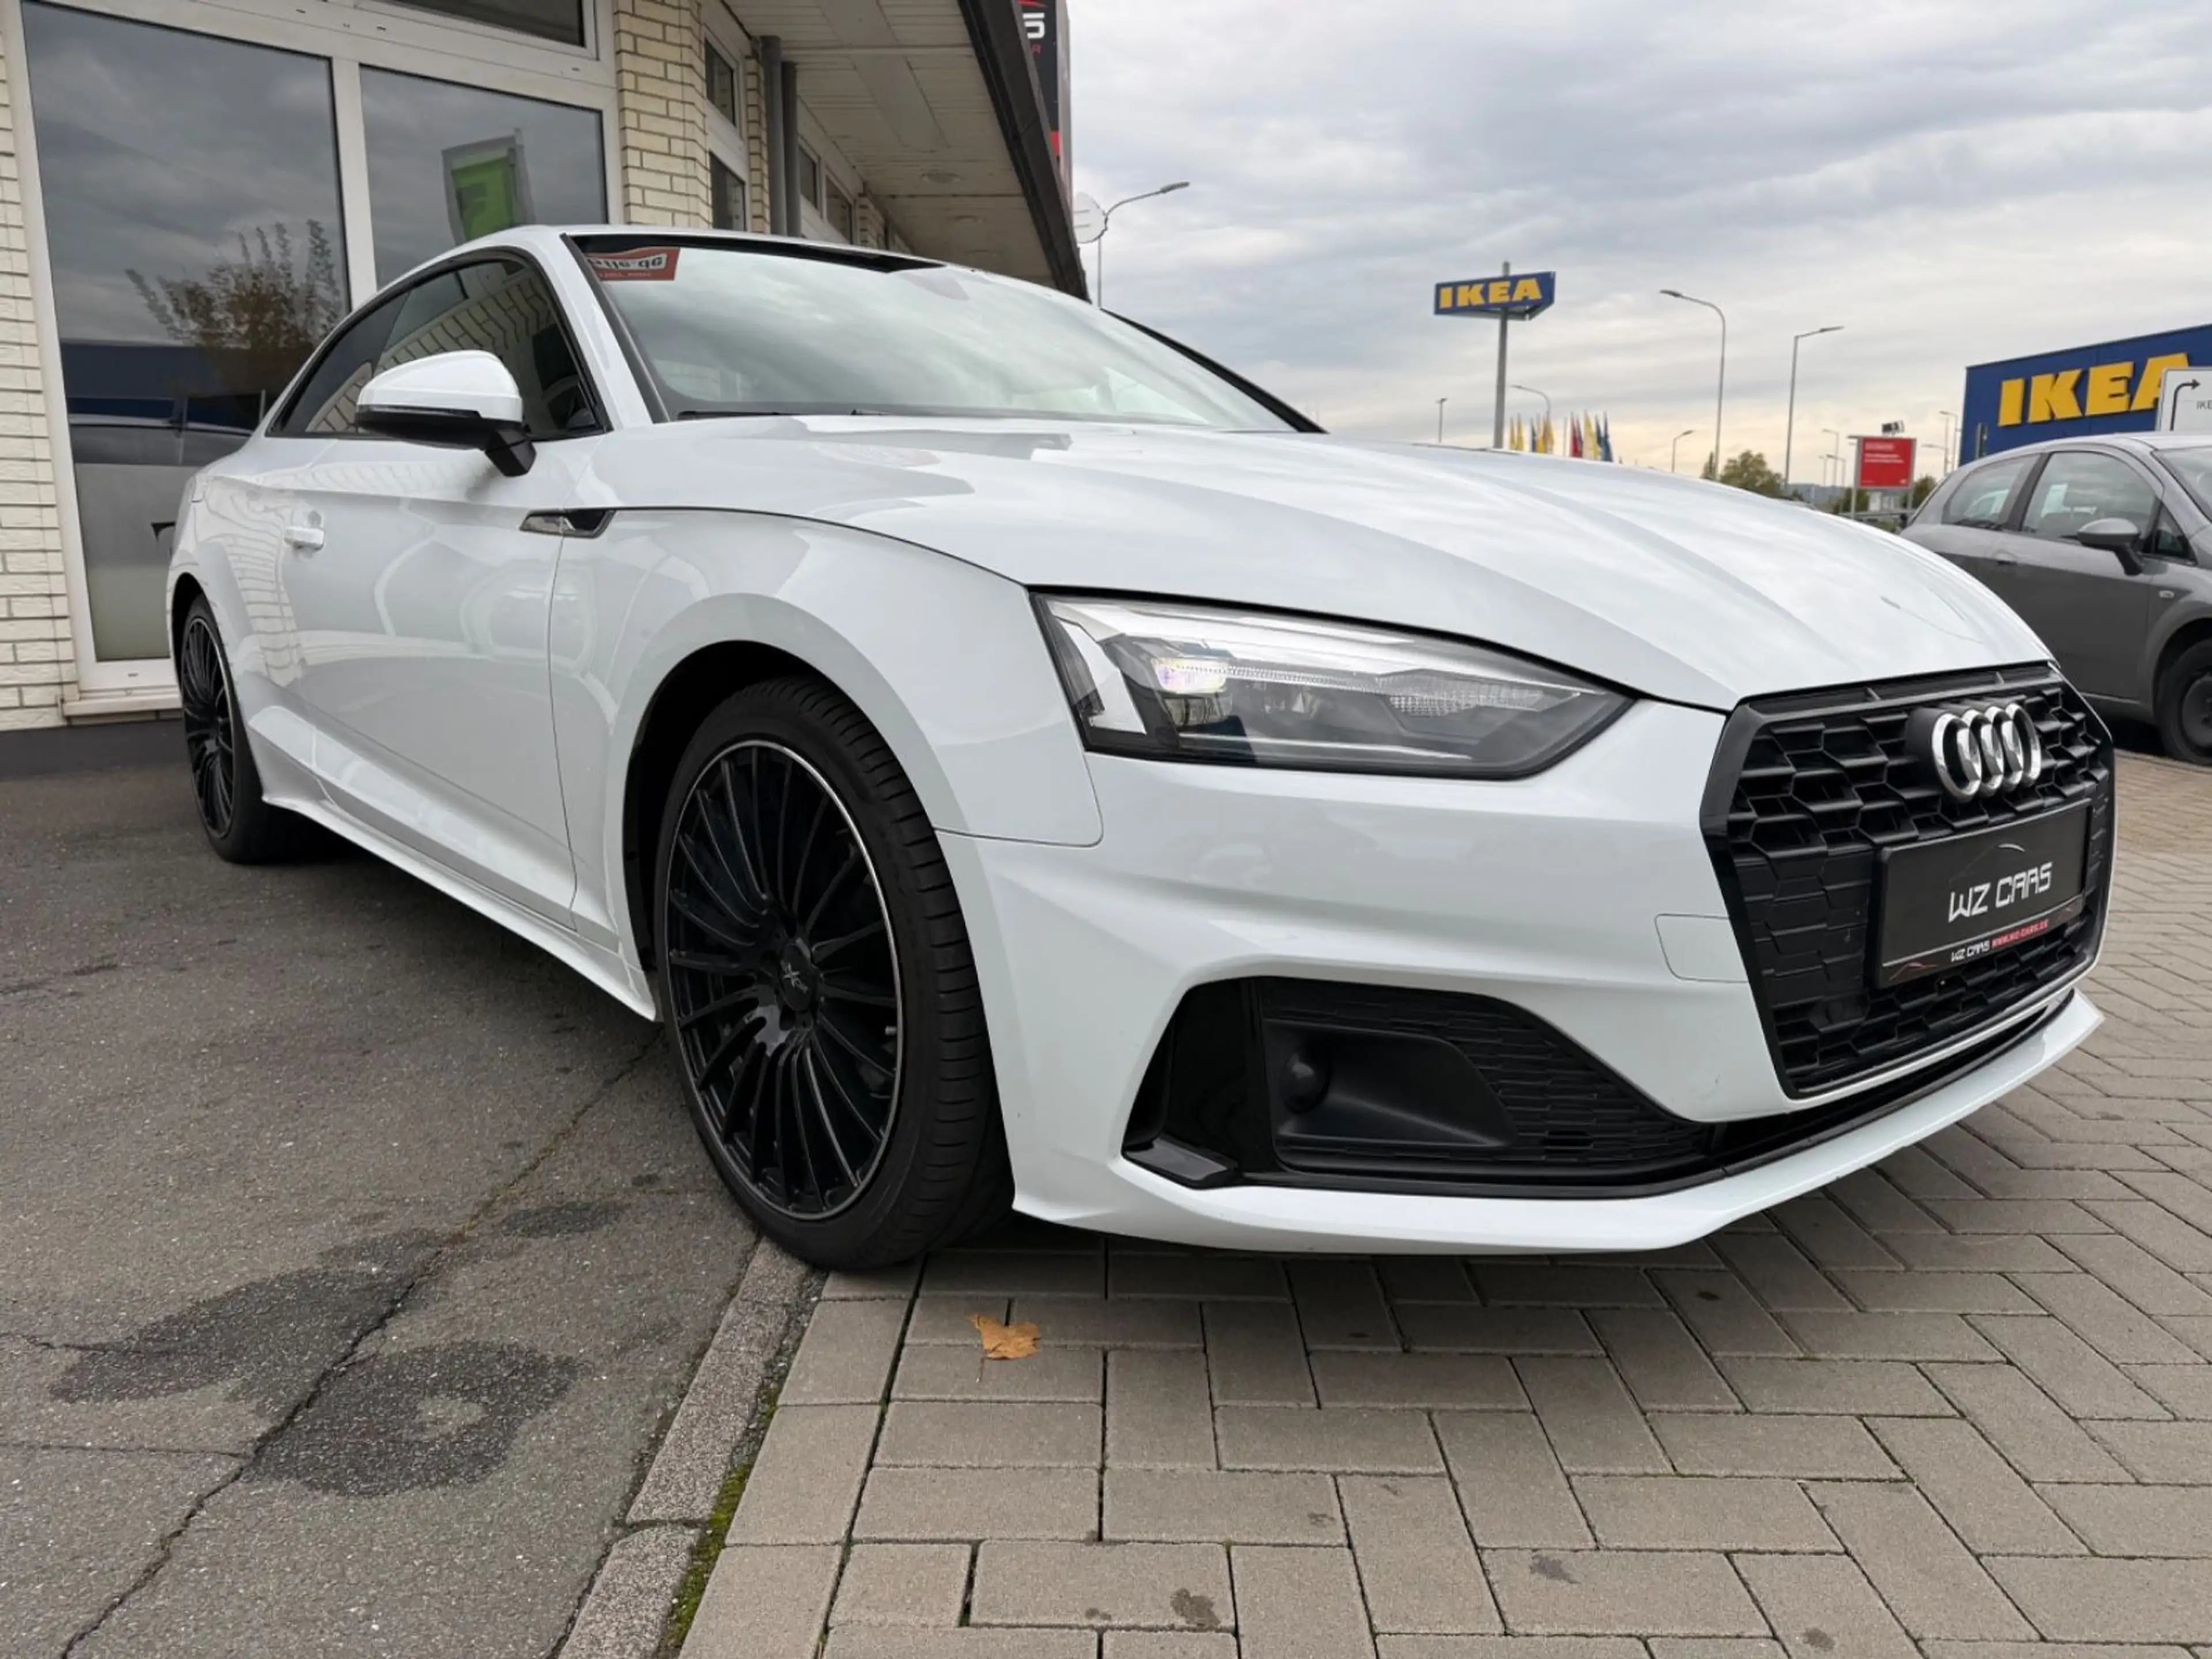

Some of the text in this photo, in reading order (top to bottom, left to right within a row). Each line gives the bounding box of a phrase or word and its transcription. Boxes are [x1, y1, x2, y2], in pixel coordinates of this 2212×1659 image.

[1440, 278, 1543, 309] IKEA
[1997, 352, 2189, 427] IKEA
[1948, 861, 2052, 923] WZ CARS
